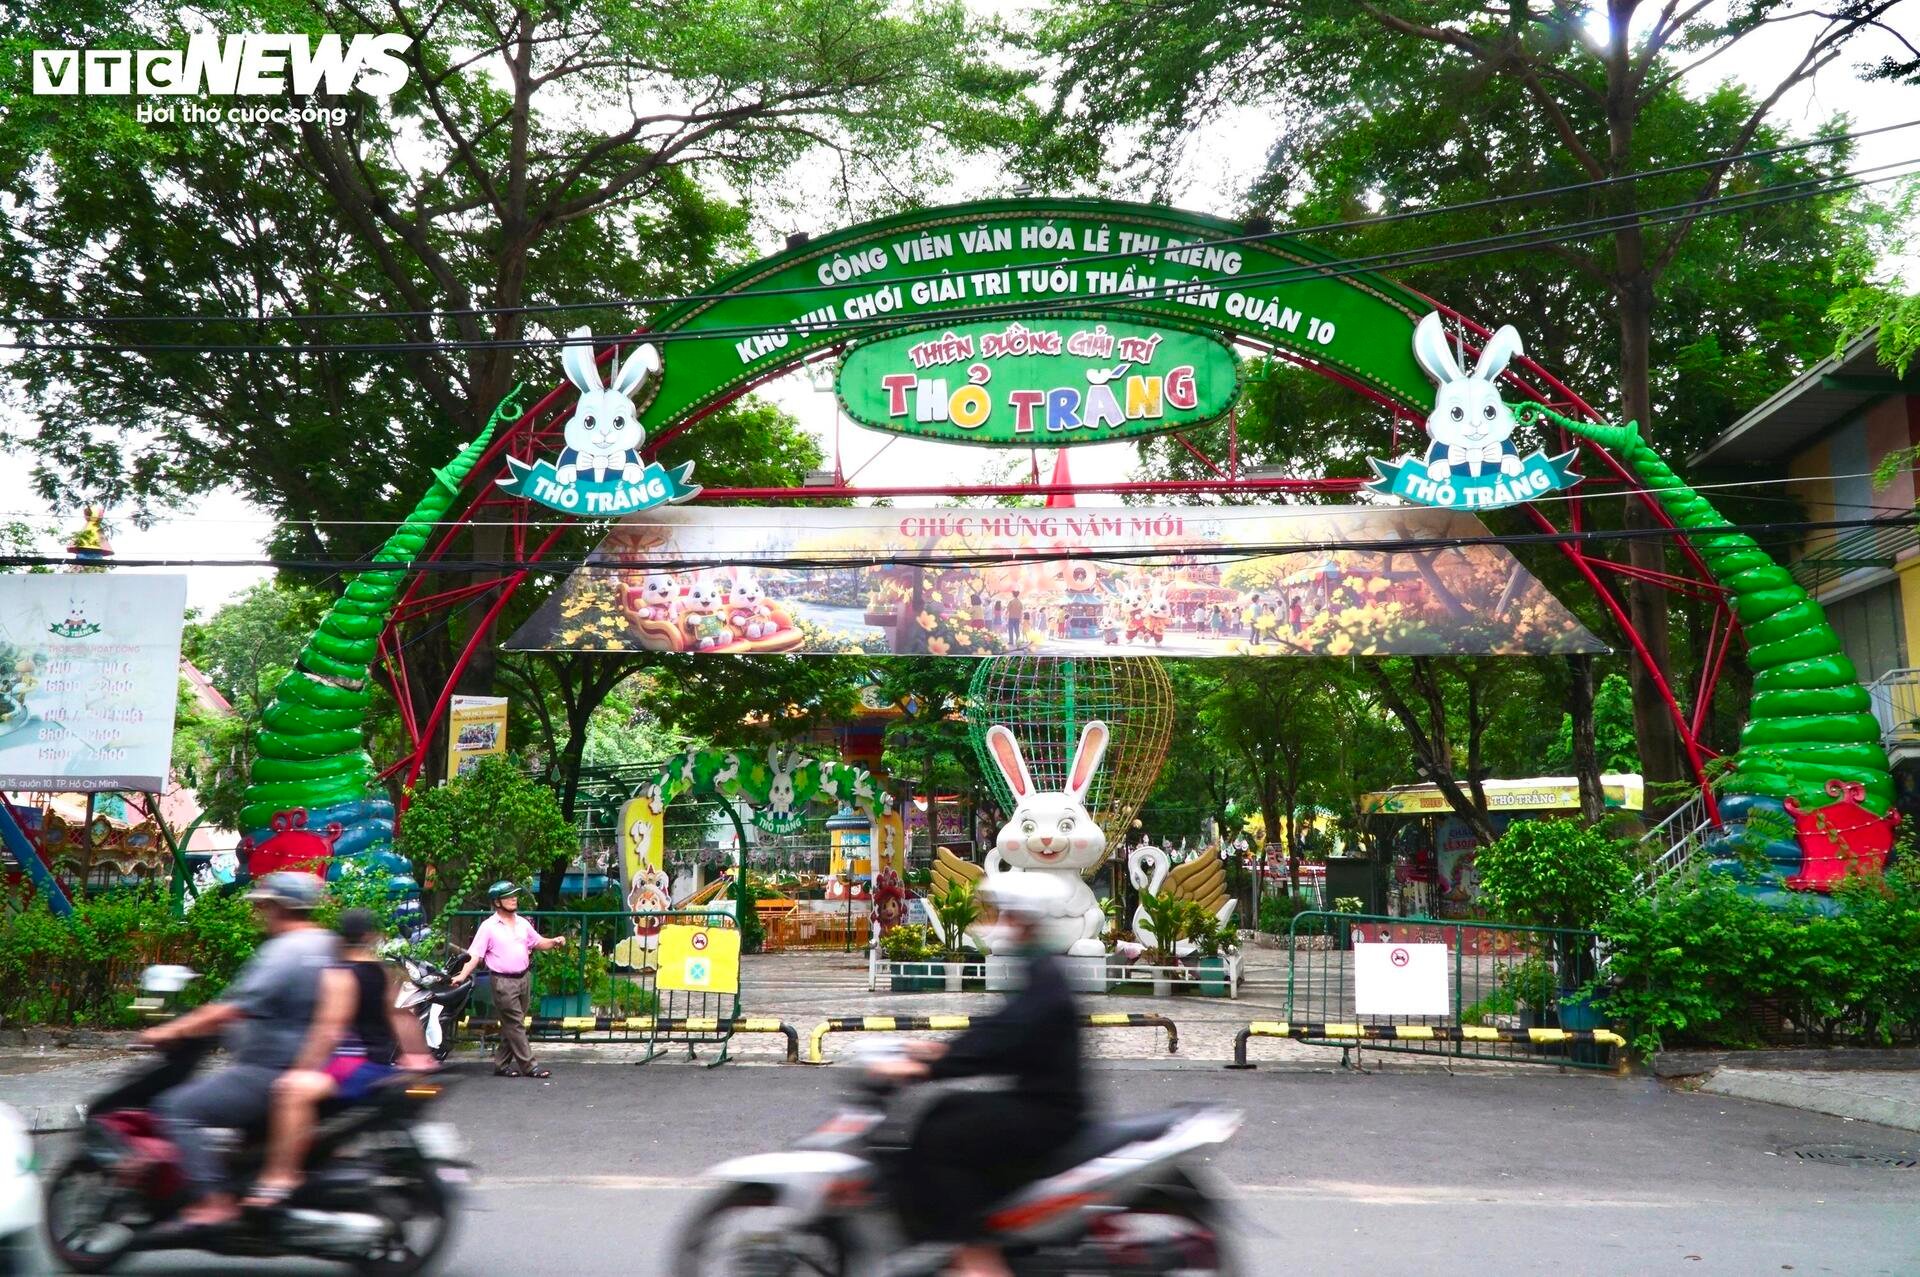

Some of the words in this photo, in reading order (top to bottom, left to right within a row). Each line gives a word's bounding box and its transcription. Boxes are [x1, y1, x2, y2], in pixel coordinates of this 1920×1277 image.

[817, 248, 889, 286] CÔNG
[892, 231, 954, 265] VIÊN
[958, 224, 1013, 254] VĂN
[1020, 219, 1076, 250] HÓA
[1083, 224, 1111, 253] LÊ
[1119, 232, 1161, 266] THỊ
[1163, 237, 1243, 275] RIÊNG
[735, 327, 789, 364] KHU
[843, 284, 904, 321] CHƠI
[910, 268, 966, 305] GIẢI
[971, 264, 1011, 297] TRÍ
[1085, 263, 1157, 298] THẦN
[1163, 275, 1221, 310] TIÊN
[1225, 296, 1303, 334] QUẬN
[1306, 317, 1336, 345] 10
[909, 331, 975, 369] THIÊN
[1067, 325, 1115, 360] GIẢI
[1118, 332, 1163, 365] TRÍ
[882, 363, 992, 429] THỎ
[1008, 362, 1198, 433] TRẮNG
[532, 476, 580, 508] THỎ
[584, 477, 667, 512] TRẮNG
[1404, 473, 1457, 506] THỎ
[1462, 468, 1552, 508] TRẮNG
[899, 513, 974, 537] CHÚC
[980, 513, 1059, 537] MỪNG
[1065, 513, 1123, 537] NĂM
[1130, 512, 1184, 537] MỚI
